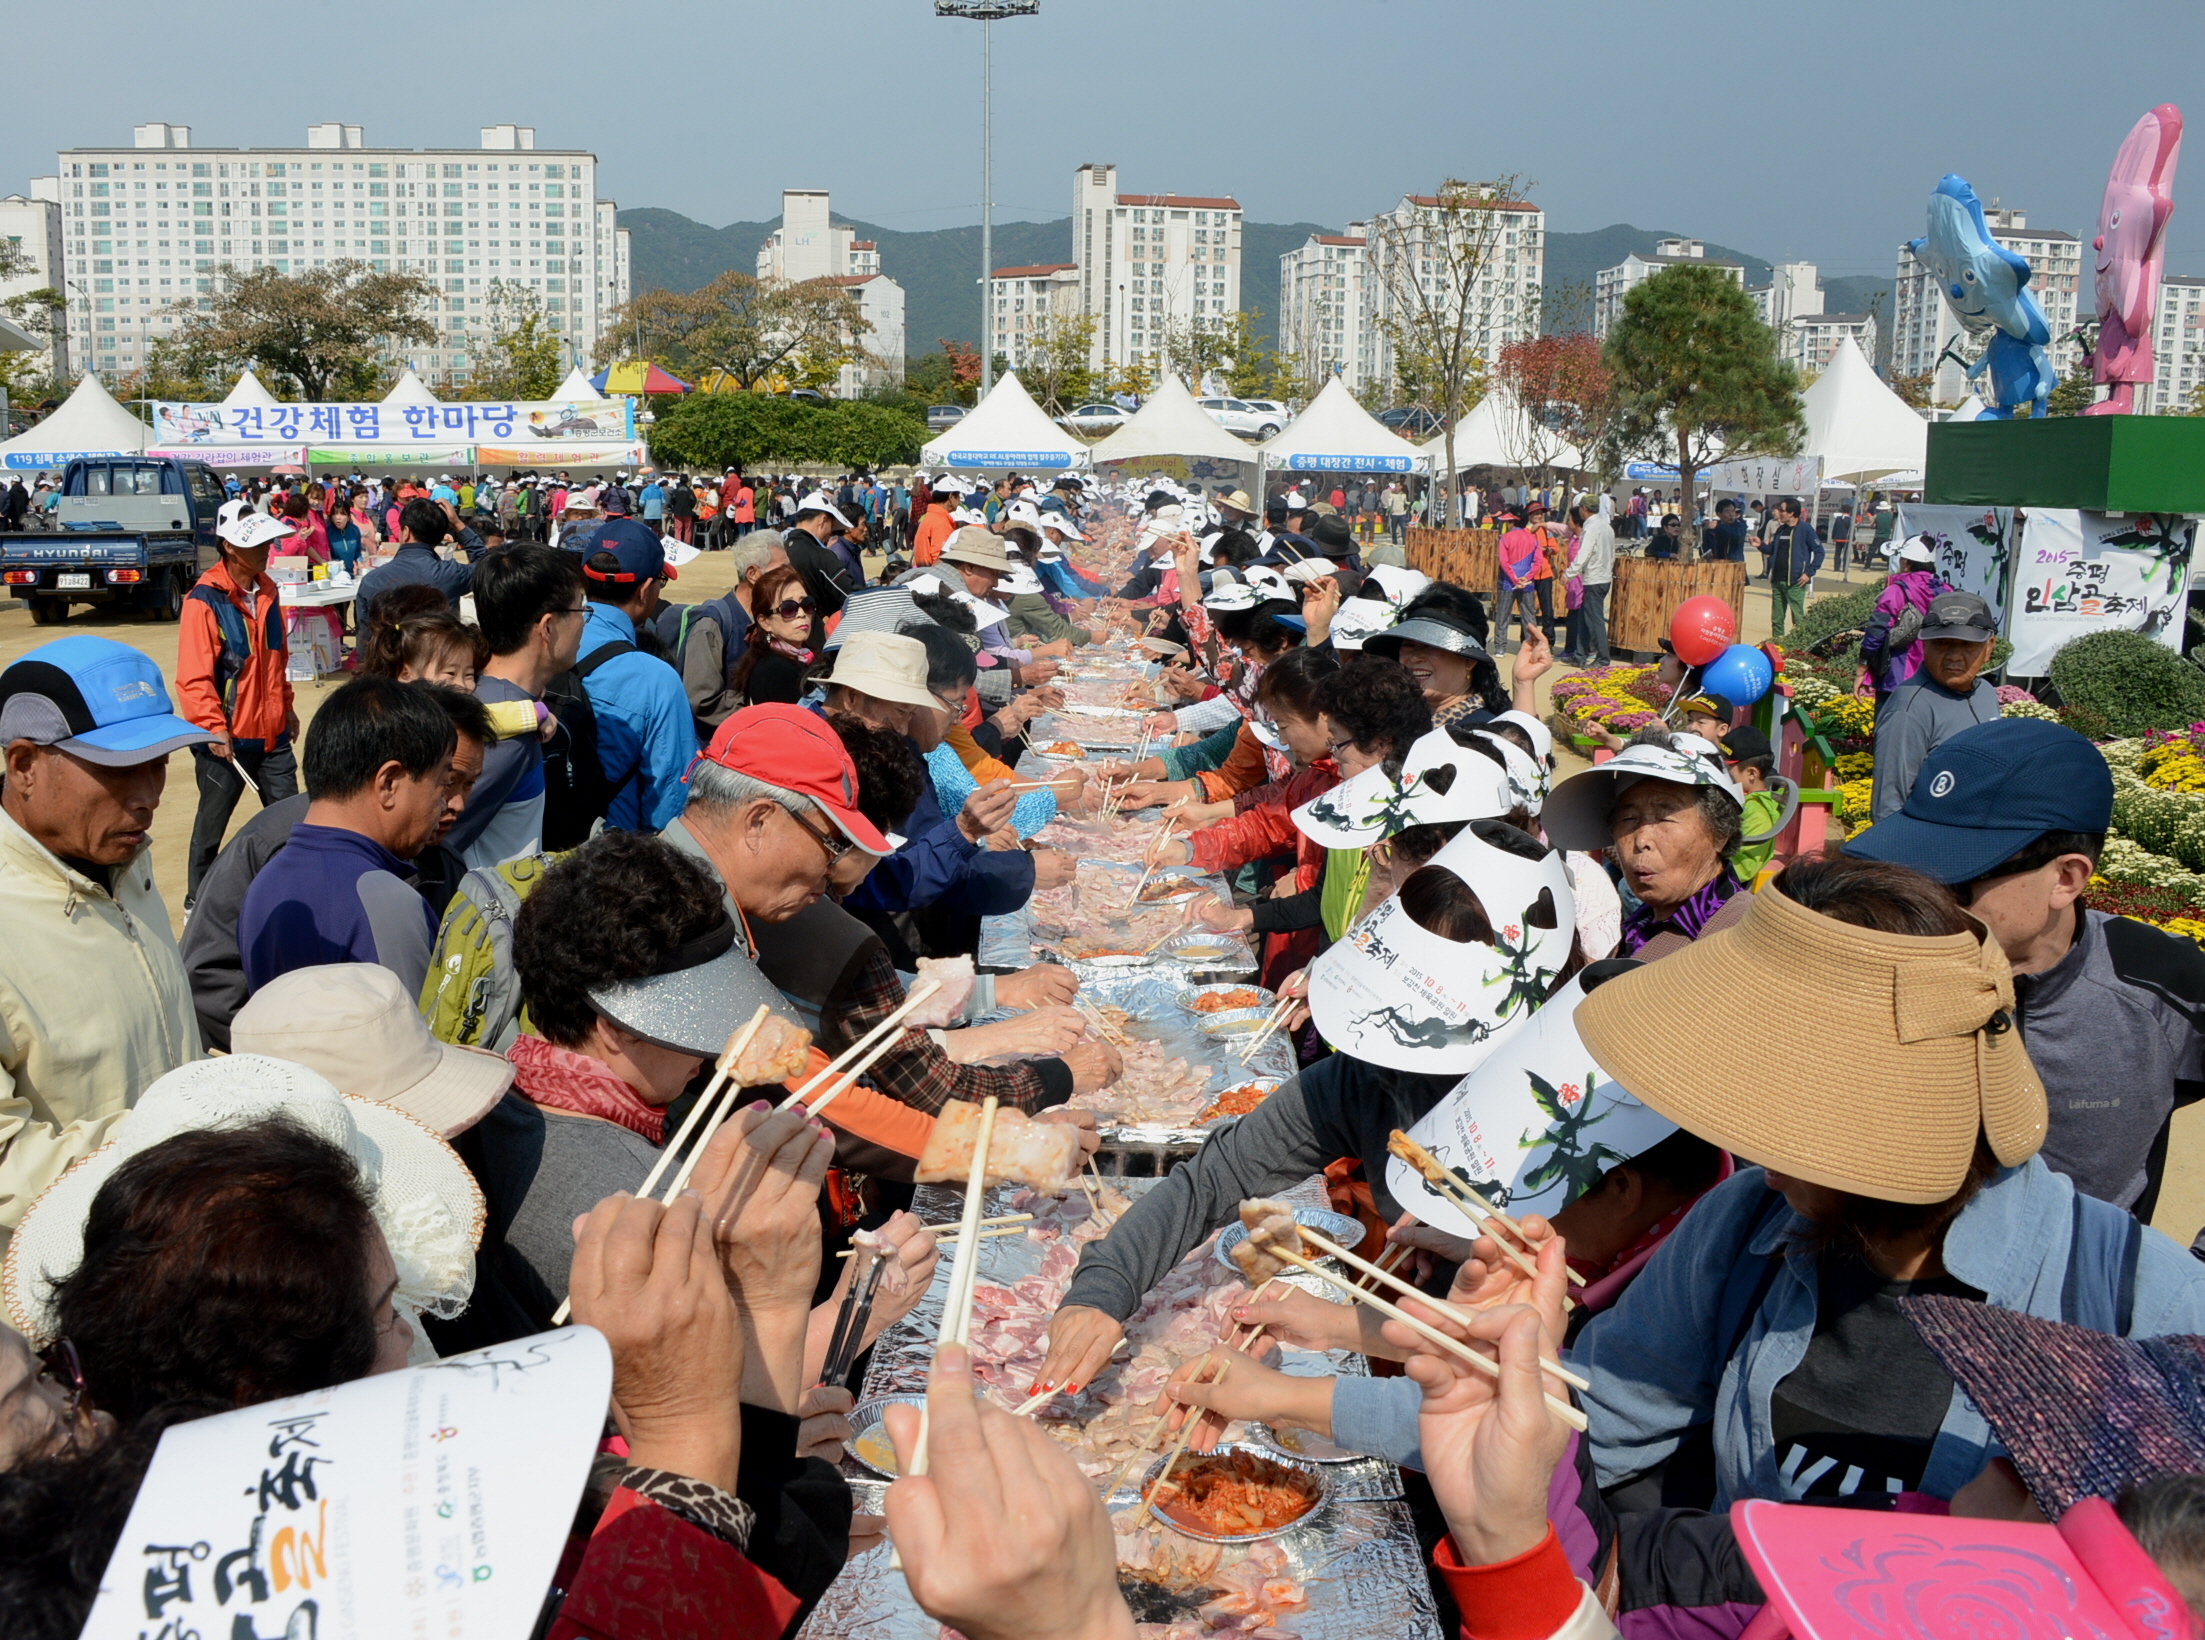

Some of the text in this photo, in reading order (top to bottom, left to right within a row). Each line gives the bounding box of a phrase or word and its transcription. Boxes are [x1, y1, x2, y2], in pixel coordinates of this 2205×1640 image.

[795, 237, 810, 246] LH
[231, 404, 519, 440] 건강체험 한마당
[574, 427, 623, 438] 증평군보건소
[13, 455, 33, 464] 119
[240, 451, 272, 463] 체험관
[1296, 456, 1317, 468] 증평
[1320, 456, 1351, 469] 대장간
[1354, 457, 1375, 469] 전시
[1384, 458, 1406, 470] 체험
[33, 549, 108, 558] HYUNDAI
[1942, 540, 1968, 578] 증평
[2035, 549, 2079, 564] 2015
[2065, 560, 2110, 584] 증평
[1408, 966, 1424, 980] 2015
[1435, 985, 1444, 995] 8
[1456, 1001, 1467, 1012] 11
[1463, 1107, 1473, 1123] 2015
[1473, 1134, 1482, 1143] 8
[1484, 1157, 1495, 1169] 11
